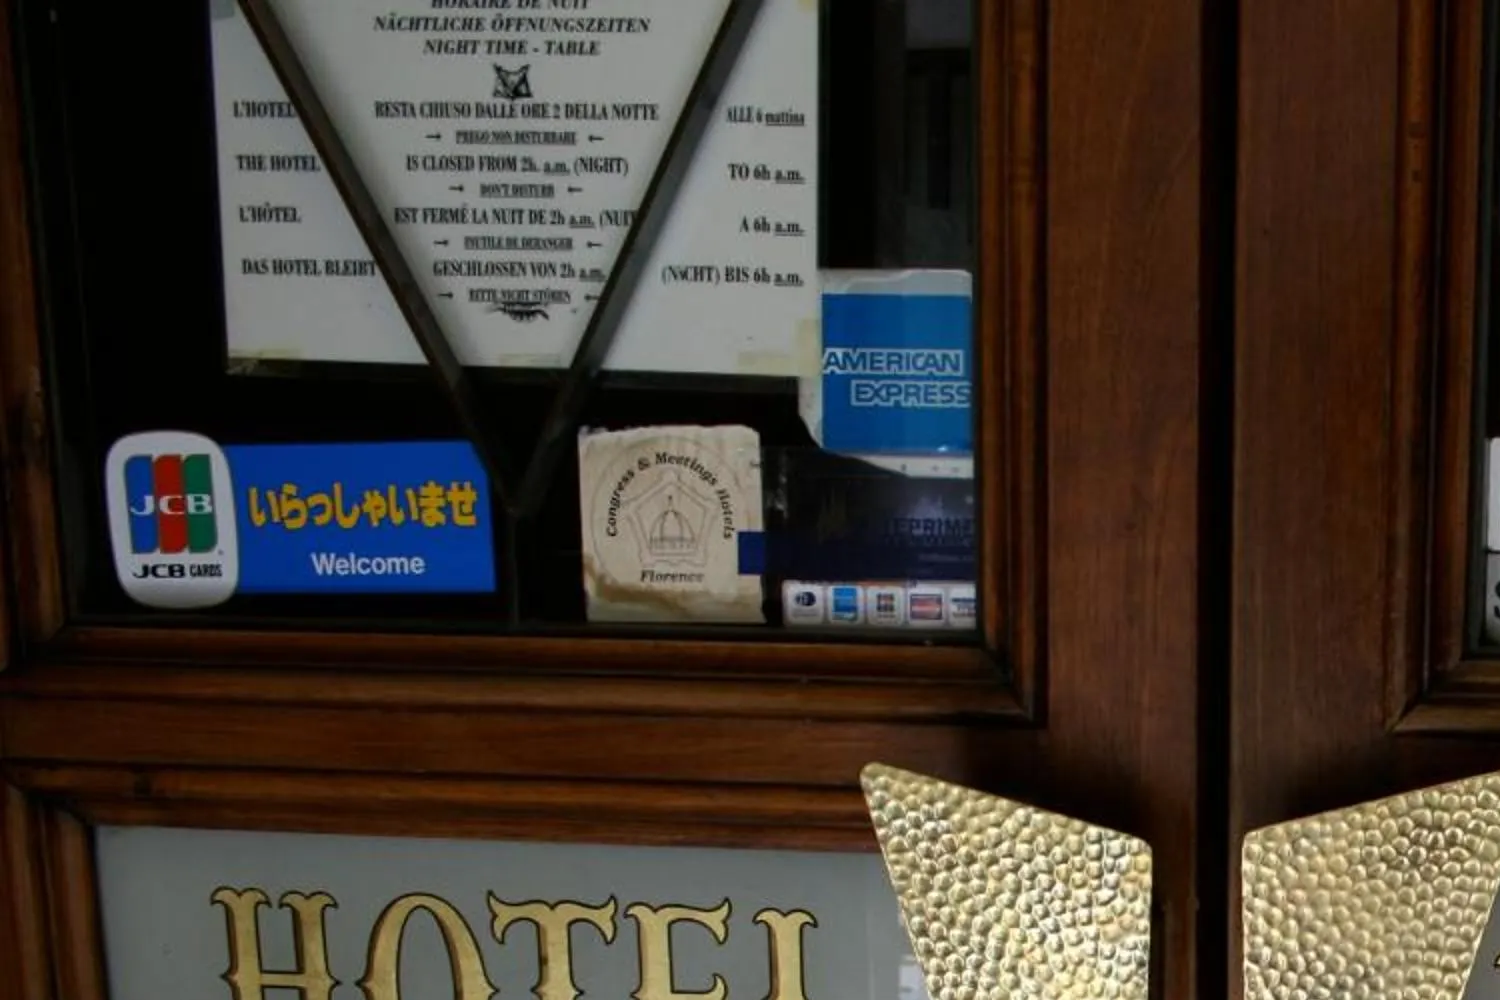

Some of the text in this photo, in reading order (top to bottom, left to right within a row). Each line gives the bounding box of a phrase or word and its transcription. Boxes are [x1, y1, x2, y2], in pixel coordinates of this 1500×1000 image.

[373, 11, 651, 33] NÄCHTLICHE ÖFFNUNGSZEITEN
[422, 39, 480, 55] NIGHT
[485, 39, 528, 55] TIME
[544, 39, 601, 56] TABLE
[375, 101, 416, 118] RESTA
[419, 101, 471, 118] CHIUSO
[475, 102, 517, 119] DALLE
[521, 103, 551, 119] ORE
[552, 104, 561, 119] 2
[564, 103, 608, 120] DELLA
[611, 103, 659, 121] NOTTE
[235, 154, 266, 172] THE
[270, 154, 321, 172] HOTEL
[406, 154, 419, 172] IS
[421, 155, 475, 172] CLOSED
[478, 155, 517, 172] FROM
[574, 157, 629, 177] (NIGHT)
[727, 163, 750, 180] TO
[394, 207, 419, 224] EST
[471, 207, 489, 225] LA
[491, 207, 524, 225] NUIT
[528, 207, 547, 225] DE
[739, 215, 750, 232] A
[241, 258, 269, 276] DAS
[272, 258, 321, 276] HOTEL
[324, 259, 376, 277] BLEIBT
[433, 261, 527, 277] GESCHLOSSEN
[530, 262, 557, 277] VON
[724, 265, 750, 283] BIS
[823, 347, 964, 376] AMERICAN
[851, 379, 972, 408] EXPRESS
[129, 493, 214, 516] JCB
[249, 481, 477, 529] いらっしゃいませ
[606, 452, 736, 540] Congress & Meetings Hotels
[132, 563, 223, 580] JCB CARDS
[310, 551, 425, 576] Welcome
[640, 569, 705, 584] Florence
